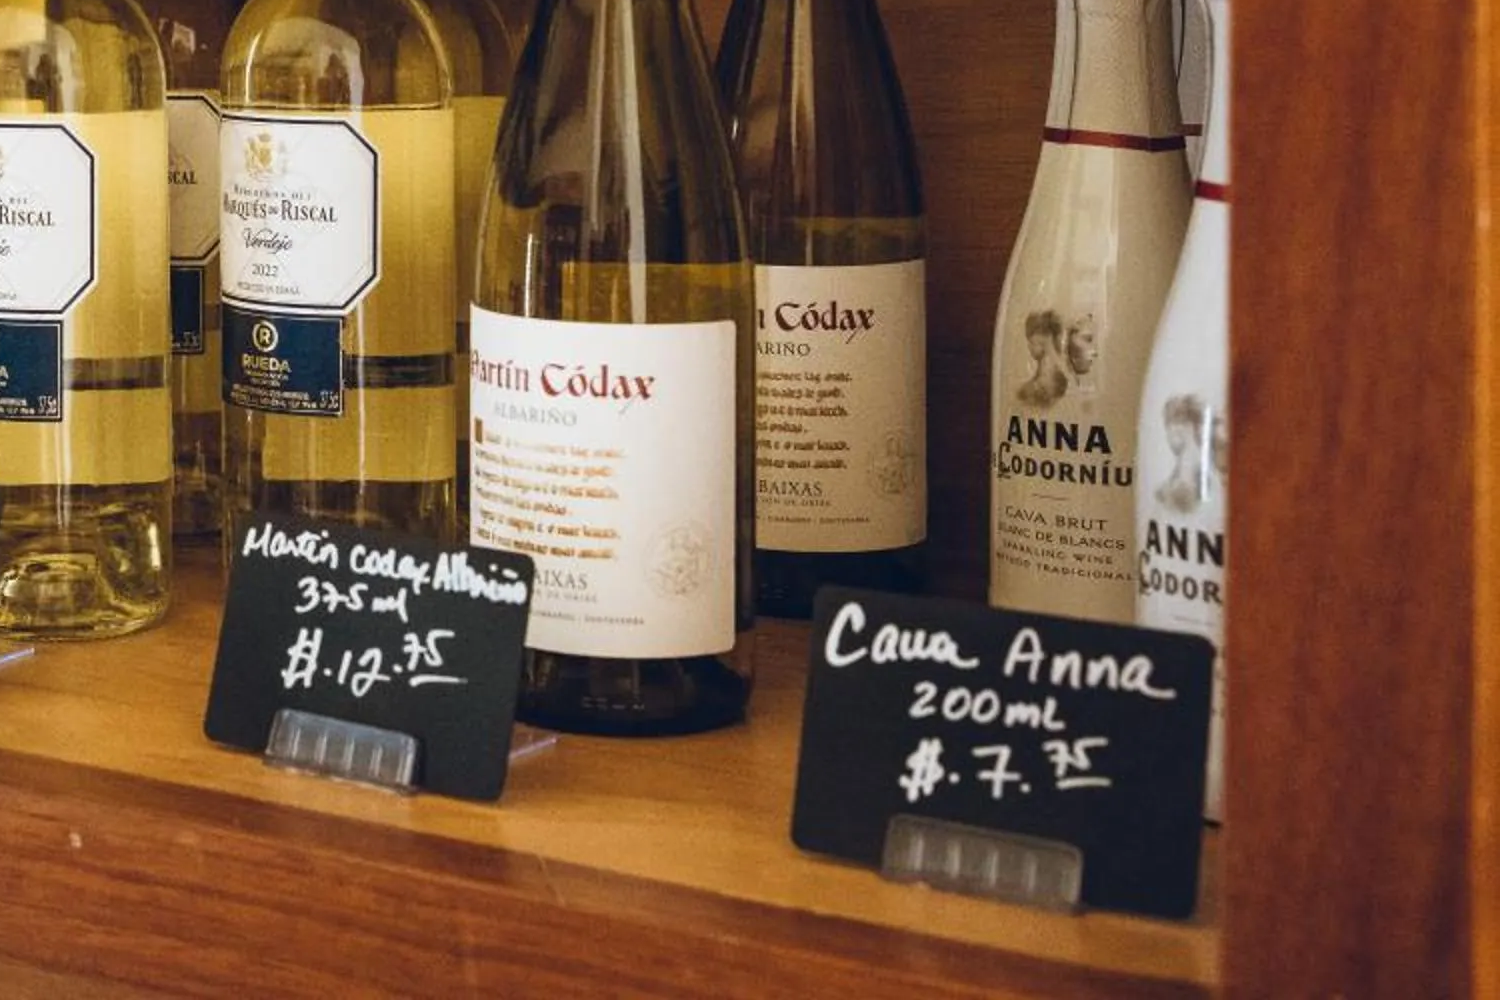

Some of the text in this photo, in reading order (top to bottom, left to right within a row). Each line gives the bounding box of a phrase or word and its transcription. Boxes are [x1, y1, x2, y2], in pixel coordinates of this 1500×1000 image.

[168, 172, 198, 184] SCAL
[0, 204, 56, 227] RISCAL
[281, 199, 339, 222] RISCAL
[243, 227, 293, 254] Verdejo
[251, 263, 279, 277] 2022
[775, 300, 876, 345] Códax
[242, 353, 293, 373] RUEDA
[540, 363, 656, 415] Códax
[493, 400, 578, 427] ALBARIÑO
[1007, 415, 1113, 454] ANNA
[997, 442, 1134, 487] CODORNÍU
[758, 479, 823, 497] BAIXAS
[1005, 505, 1109, 531] CAVA BRUT
[1035, 531, 1054, 543] DE
[1059, 535, 1126, 551] BLANCS
[1146, 519, 1224, 568] ANN
[242, 522, 339, 569] Martin
[350, 544, 431, 595] Codax
[1073, 554, 1114, 565] WINE
[534, 569, 588, 590] AIXAS
[1037, 562, 1134, 582] TRADICIONAL
[1138, 550, 1224, 608] CODOR
[1002, 626, 1177, 700] Anna
